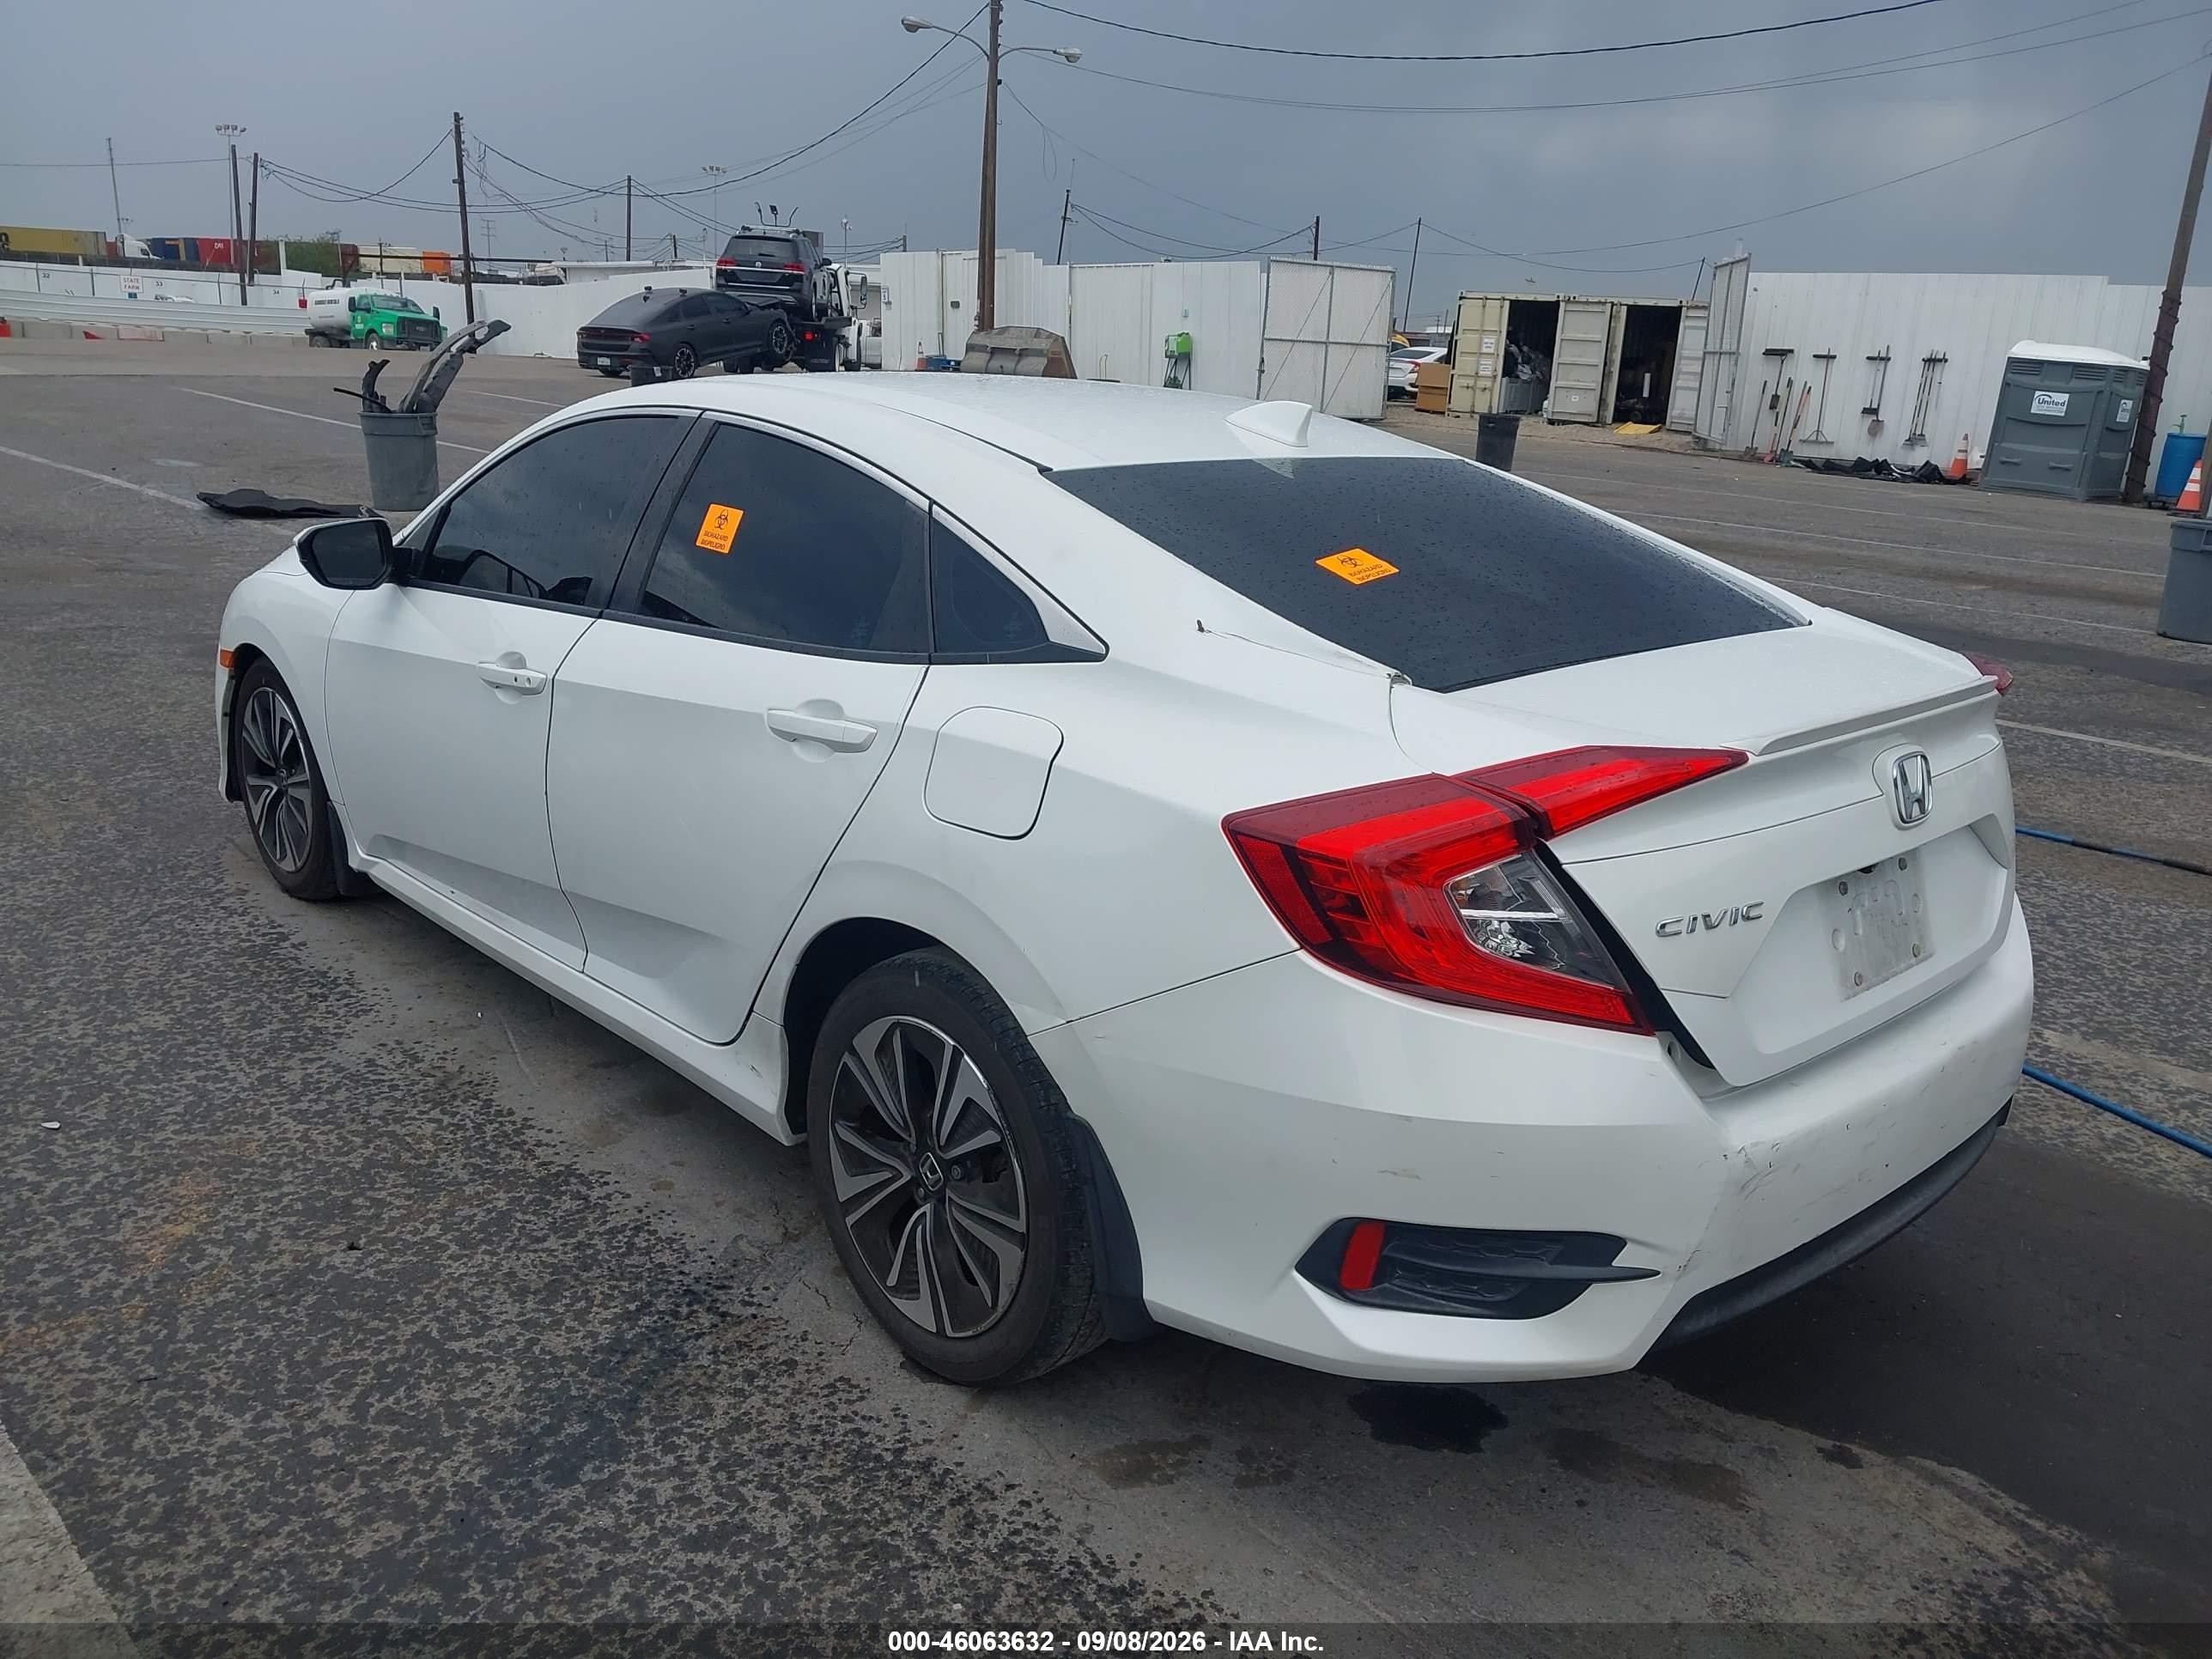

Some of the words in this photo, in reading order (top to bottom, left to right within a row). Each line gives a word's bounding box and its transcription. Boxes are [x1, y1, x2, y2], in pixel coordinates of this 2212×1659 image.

[2038, 398, 2065, 406] United
[703, 530, 729, 542] BIOHAZARD
[1656, 900, 1765, 938] CIVIC
